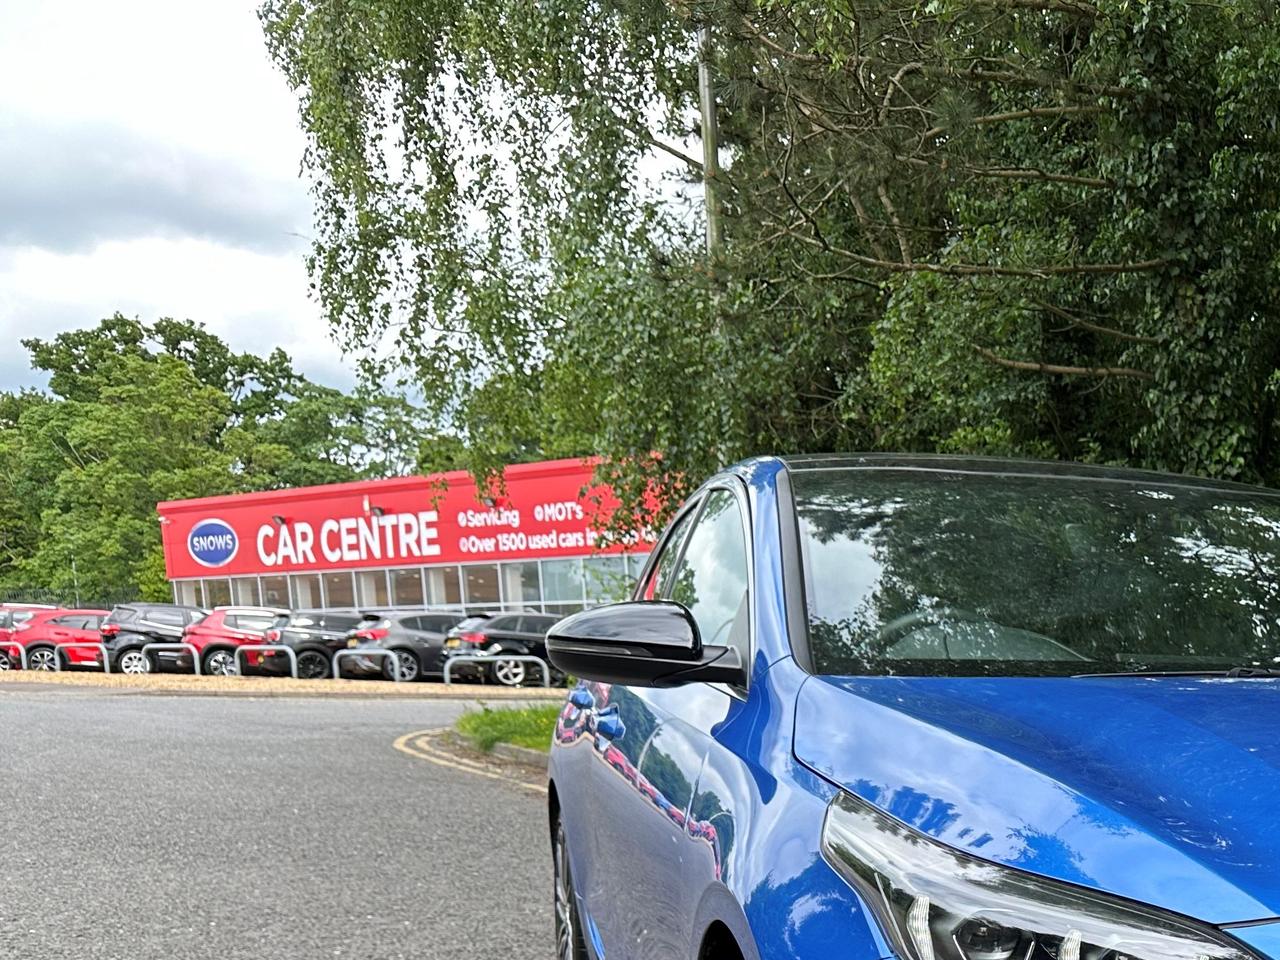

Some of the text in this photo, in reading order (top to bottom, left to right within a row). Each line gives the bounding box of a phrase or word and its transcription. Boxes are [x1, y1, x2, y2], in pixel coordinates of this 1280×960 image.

[467, 507, 520, 527] Servicing
[543, 501, 584, 522] MOT's
[192, 533, 234, 551] SNOWS
[256, 510, 441, 567] CAR CENTRE
[467, 536, 497, 553] Over
[498, 532, 527, 552] 1500
[528, 529, 557, 549] used
[558, 531, 585, 549] cars
